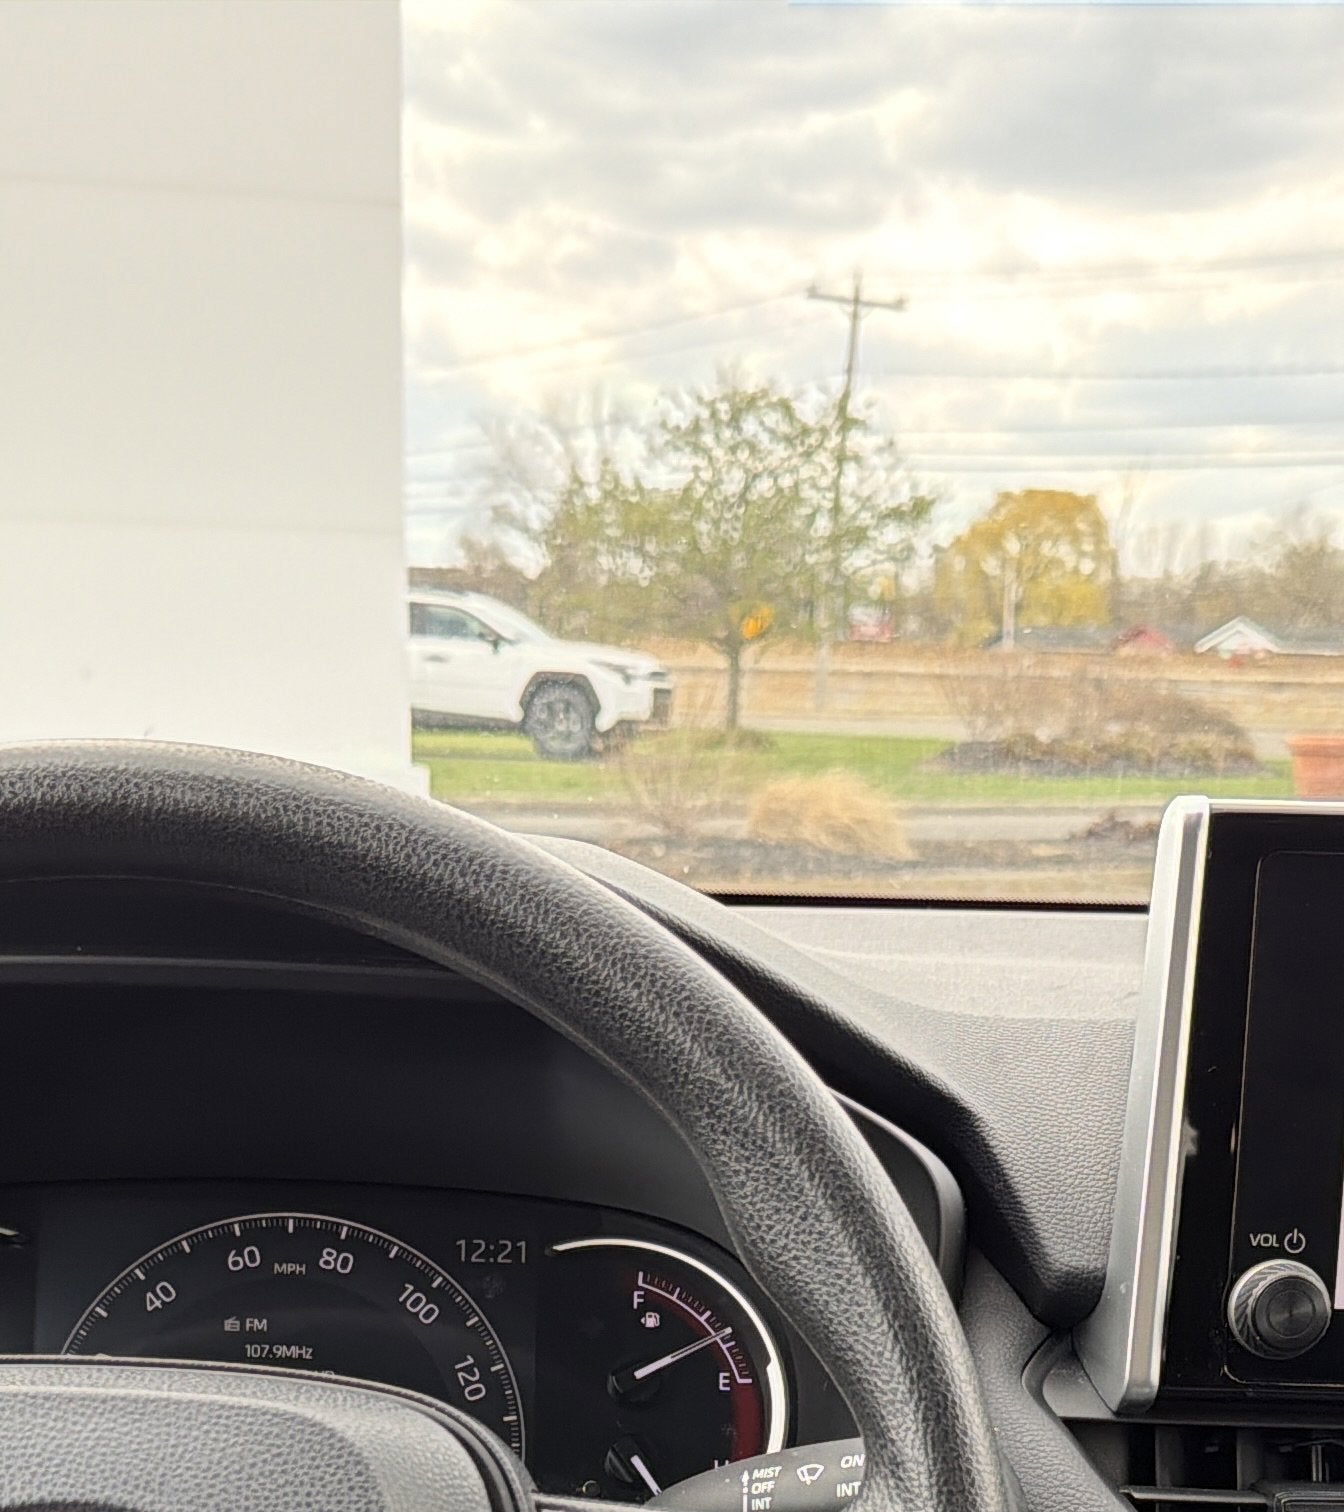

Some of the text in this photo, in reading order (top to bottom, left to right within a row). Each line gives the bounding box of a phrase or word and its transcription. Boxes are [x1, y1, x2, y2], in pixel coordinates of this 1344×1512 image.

[1249, 1233, 1279, 1248] VOL
[227, 1246, 262, 1273] 60
[456, 1239, 527, 1265] 12:21
[273, 1262, 306, 1276] MPH
[318, 1247, 354, 1275] 80
[144, 1281, 177, 1312] 40
[396, 1282, 441, 1325] 100
[634, 1291, 644, 1310] F
[246, 1318, 267, 1332] FM
[245, 1343, 313, 1360] 107.9MHz
[453, 1355, 487, 1401] 120
[719, 1373, 731, 1391] E
[752, 1466, 782, 1480] MIST
[751, 1481, 776, 1494] OFF
[836, 1481, 861, 1497] INT
[751, 1497, 772, 1511] INT
